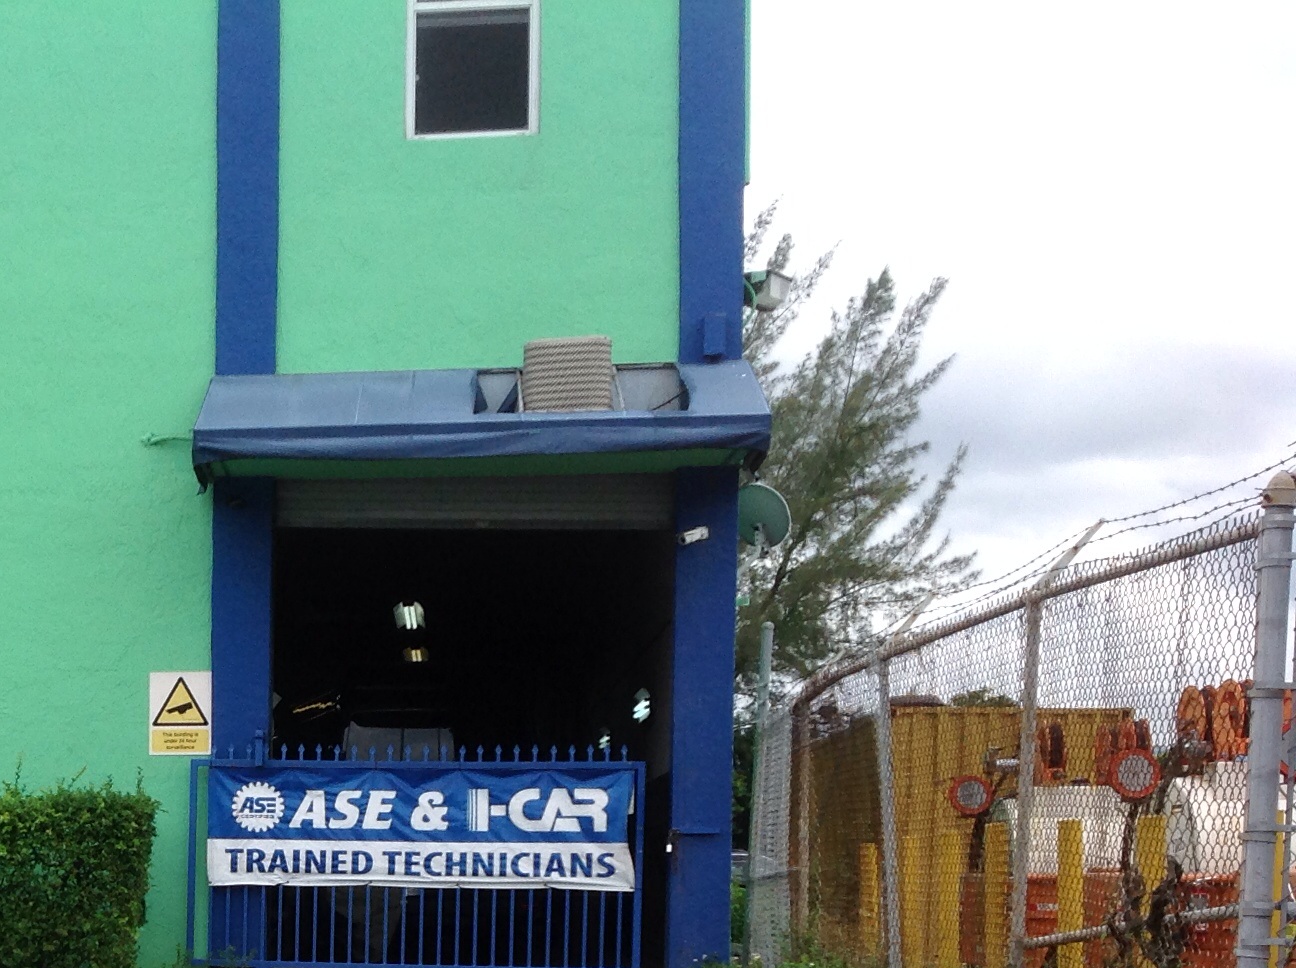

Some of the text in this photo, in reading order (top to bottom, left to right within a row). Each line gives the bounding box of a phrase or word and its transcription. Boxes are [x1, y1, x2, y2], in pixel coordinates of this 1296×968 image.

[239, 796, 276, 813] ASE
[289, 788, 609, 832] ASE & I-CAR
[225, 848, 616, 878] TRAINED TECHNICIANS
